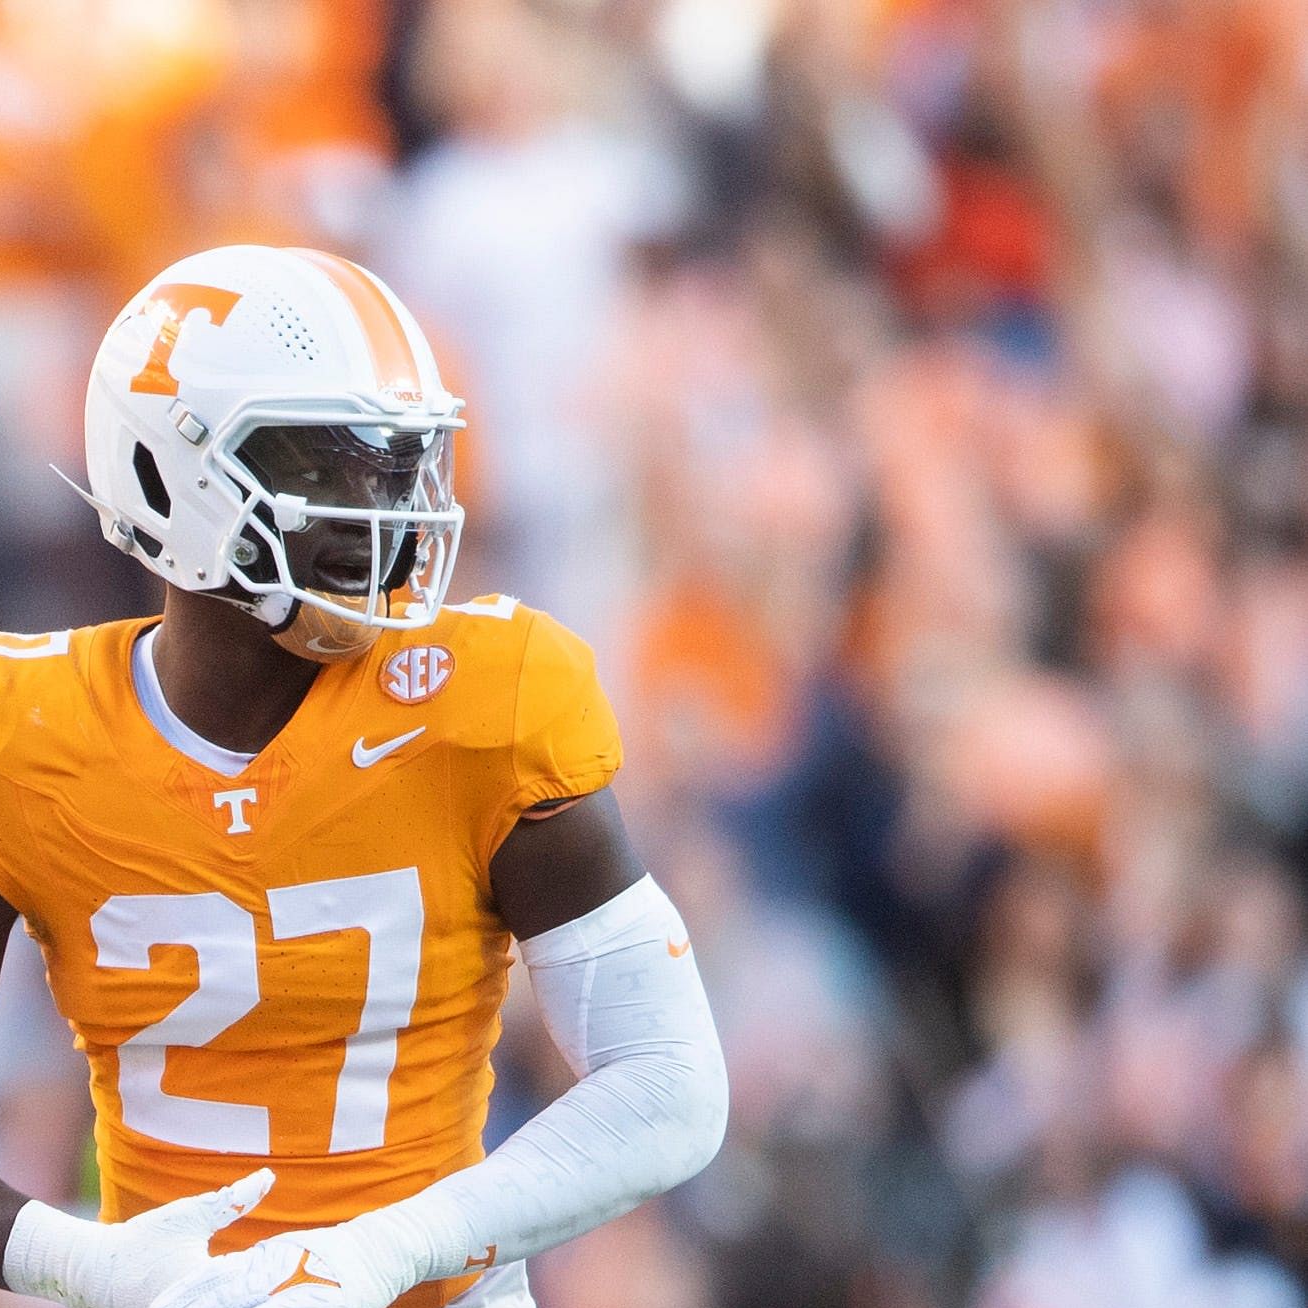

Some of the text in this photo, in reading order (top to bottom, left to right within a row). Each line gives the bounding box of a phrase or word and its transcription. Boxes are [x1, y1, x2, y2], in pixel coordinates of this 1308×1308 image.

[130, 283, 244, 397] T
[393, 391, 423, 402] VOLS
[386, 646, 450, 699] SEC
[212, 787, 258, 835] T
[89, 866, 423, 1155] 27
